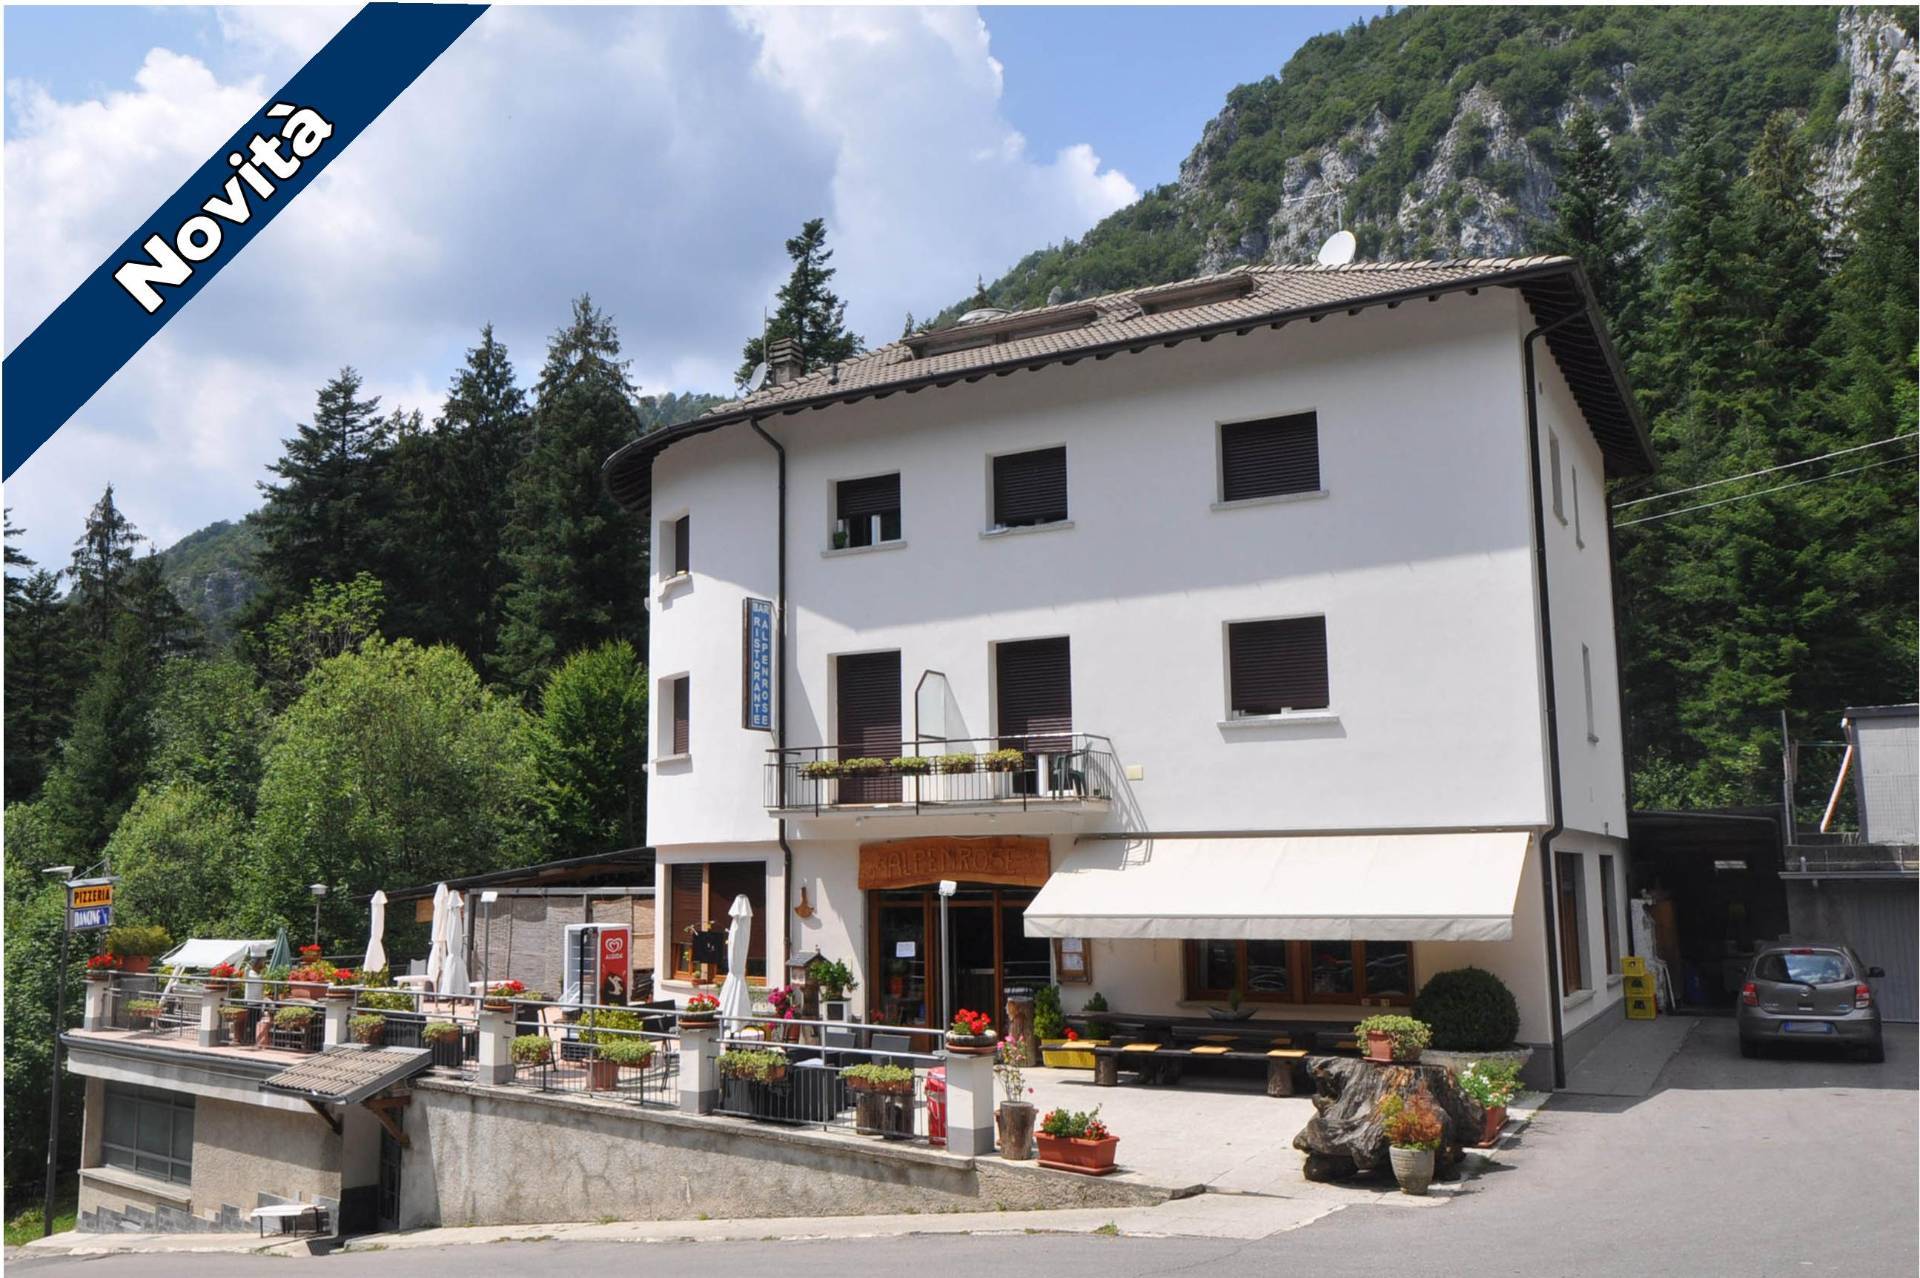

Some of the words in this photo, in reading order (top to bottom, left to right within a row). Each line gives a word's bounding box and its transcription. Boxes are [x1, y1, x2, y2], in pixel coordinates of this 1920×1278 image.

[752, 602, 769, 613] BAR
[753, 616, 761, 724] RISTORANTE
[761, 619, 769, 725] ALPENROSE
[886, 847, 1016, 878] ALPENROSE
[74, 888, 110, 904] PIZZERIA
[74, 909, 100, 927] DANCING
